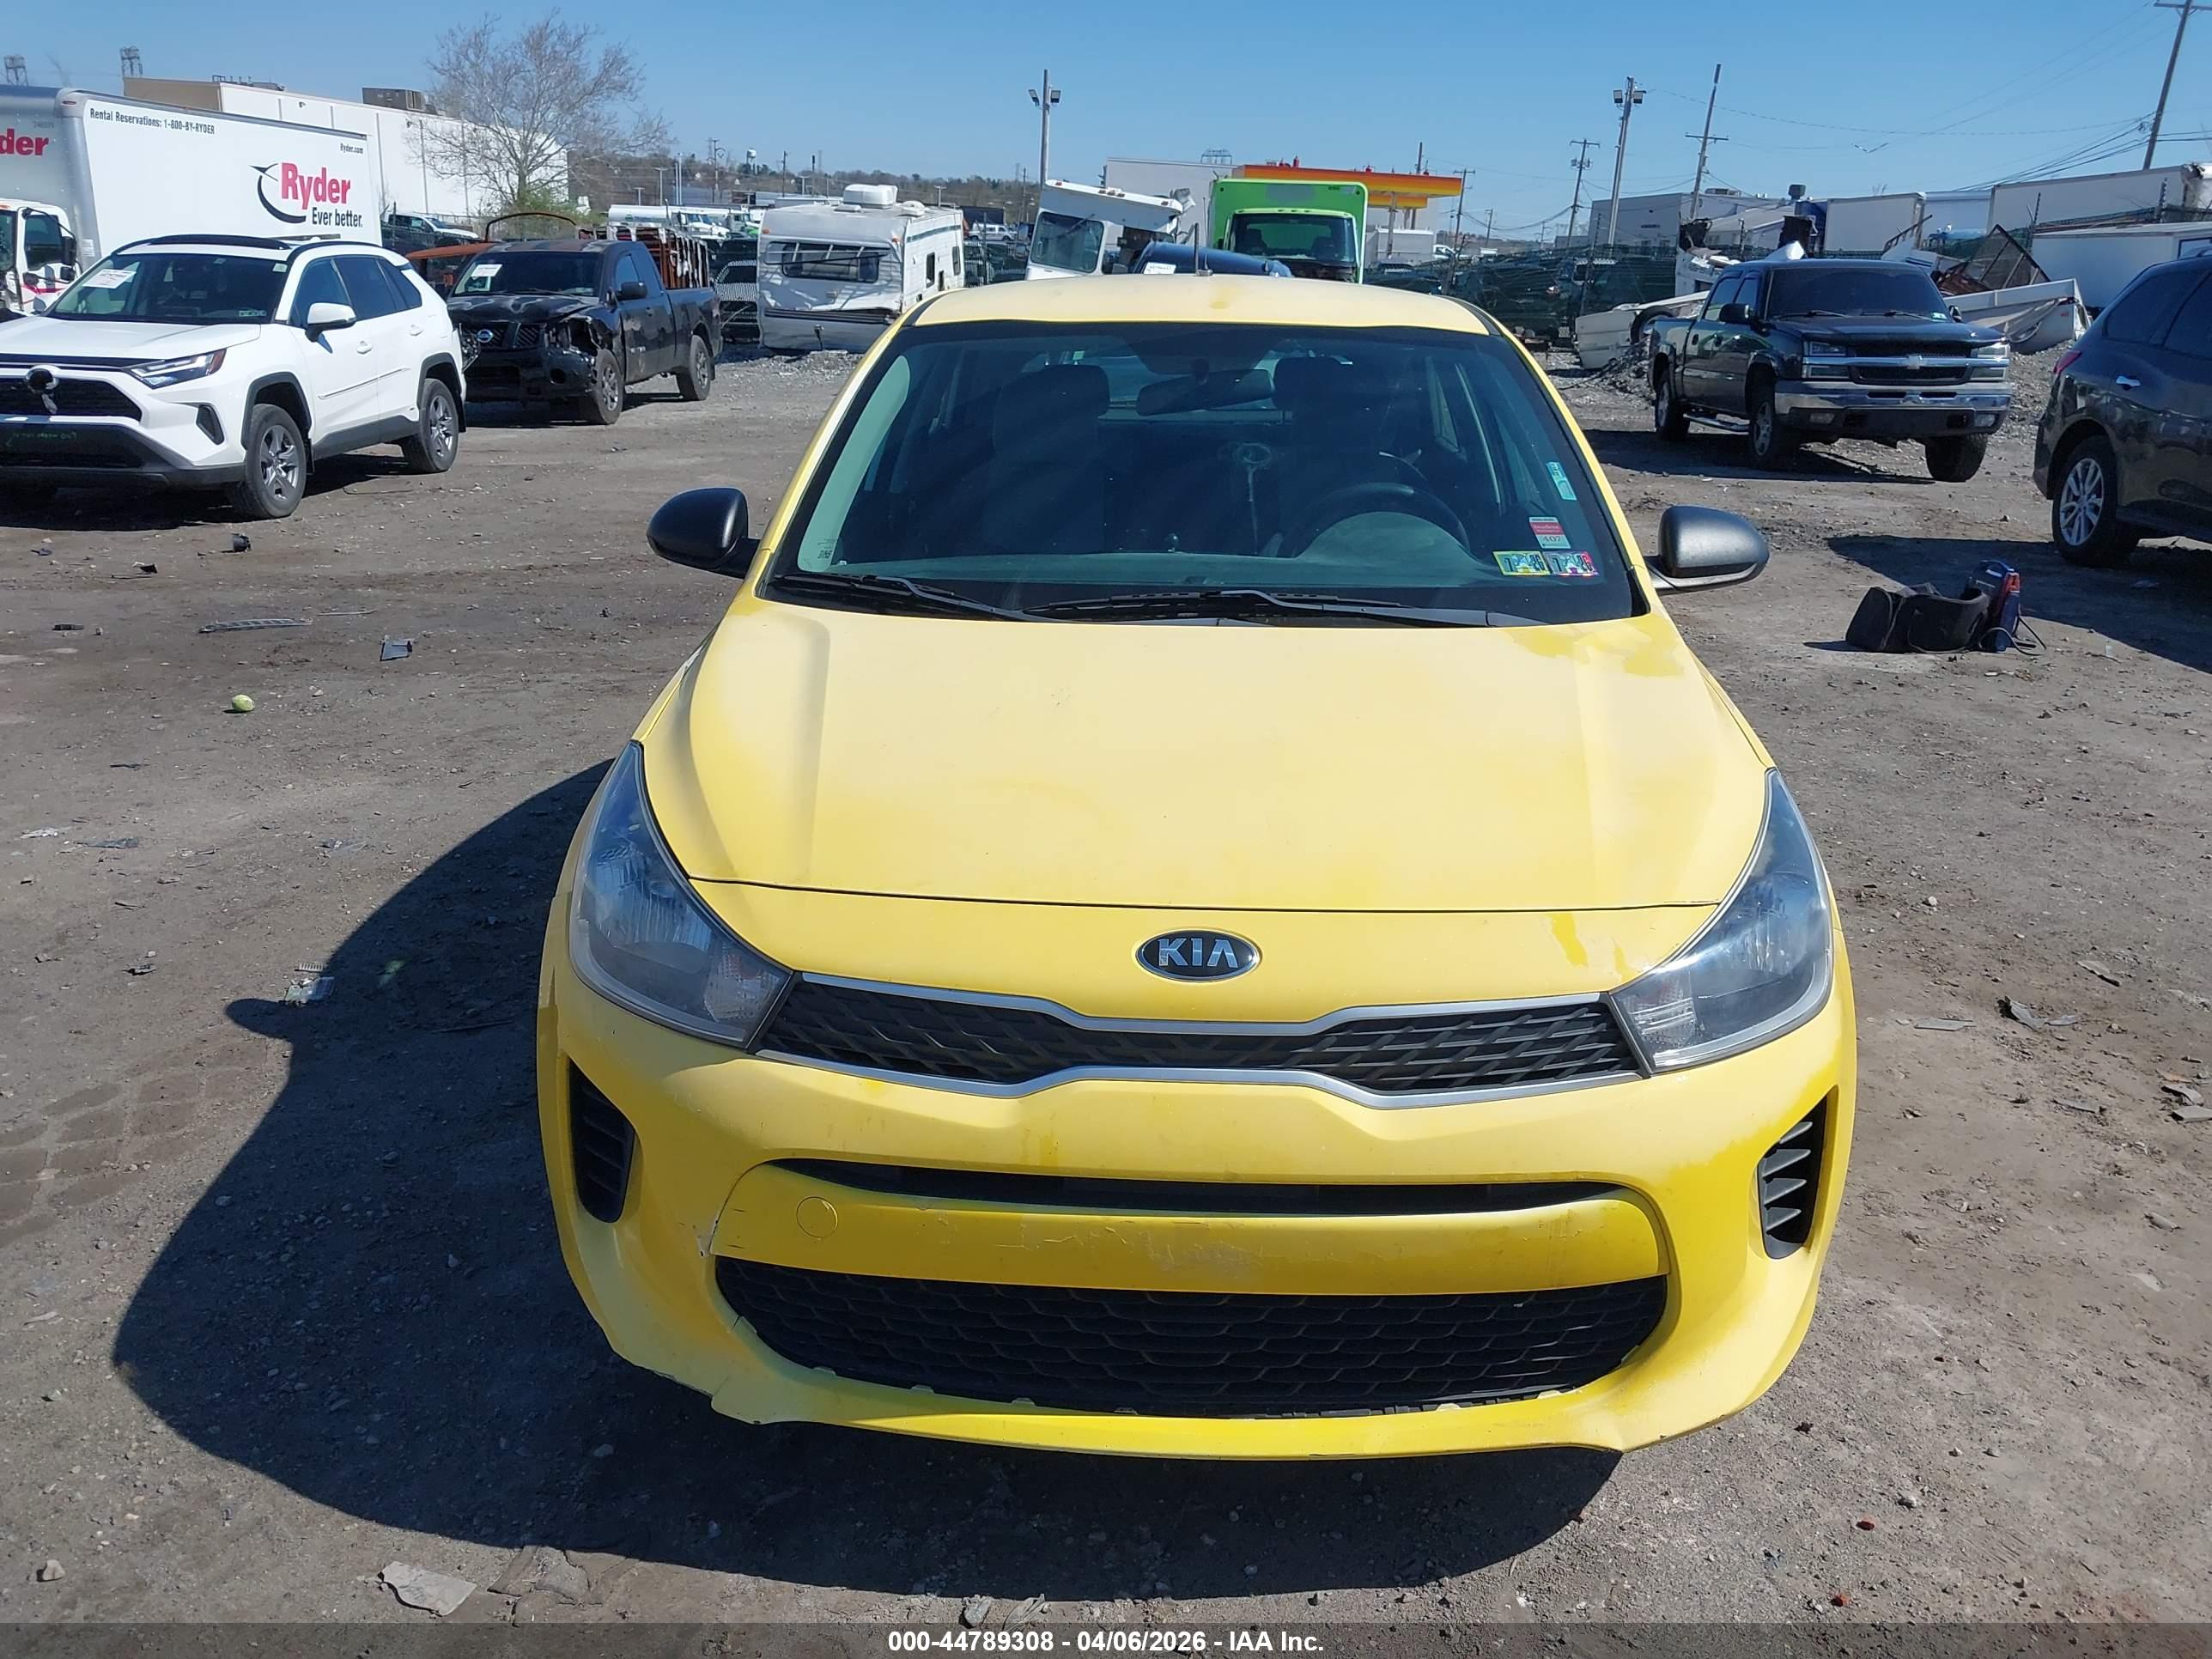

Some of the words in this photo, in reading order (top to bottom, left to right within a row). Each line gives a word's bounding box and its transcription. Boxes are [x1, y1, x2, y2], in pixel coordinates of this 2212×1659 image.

[89, 107, 113, 121] Rental
[115, 112, 162, 128] Reservations:
[164, 119, 216, 135] 1-800-BY-RYDER
[340, 143, 363, 154] Ryder.com
[282, 162, 350, 210] Ryder
[312, 207, 333, 226] Ever
[1158, 938, 1238, 969] KIA
